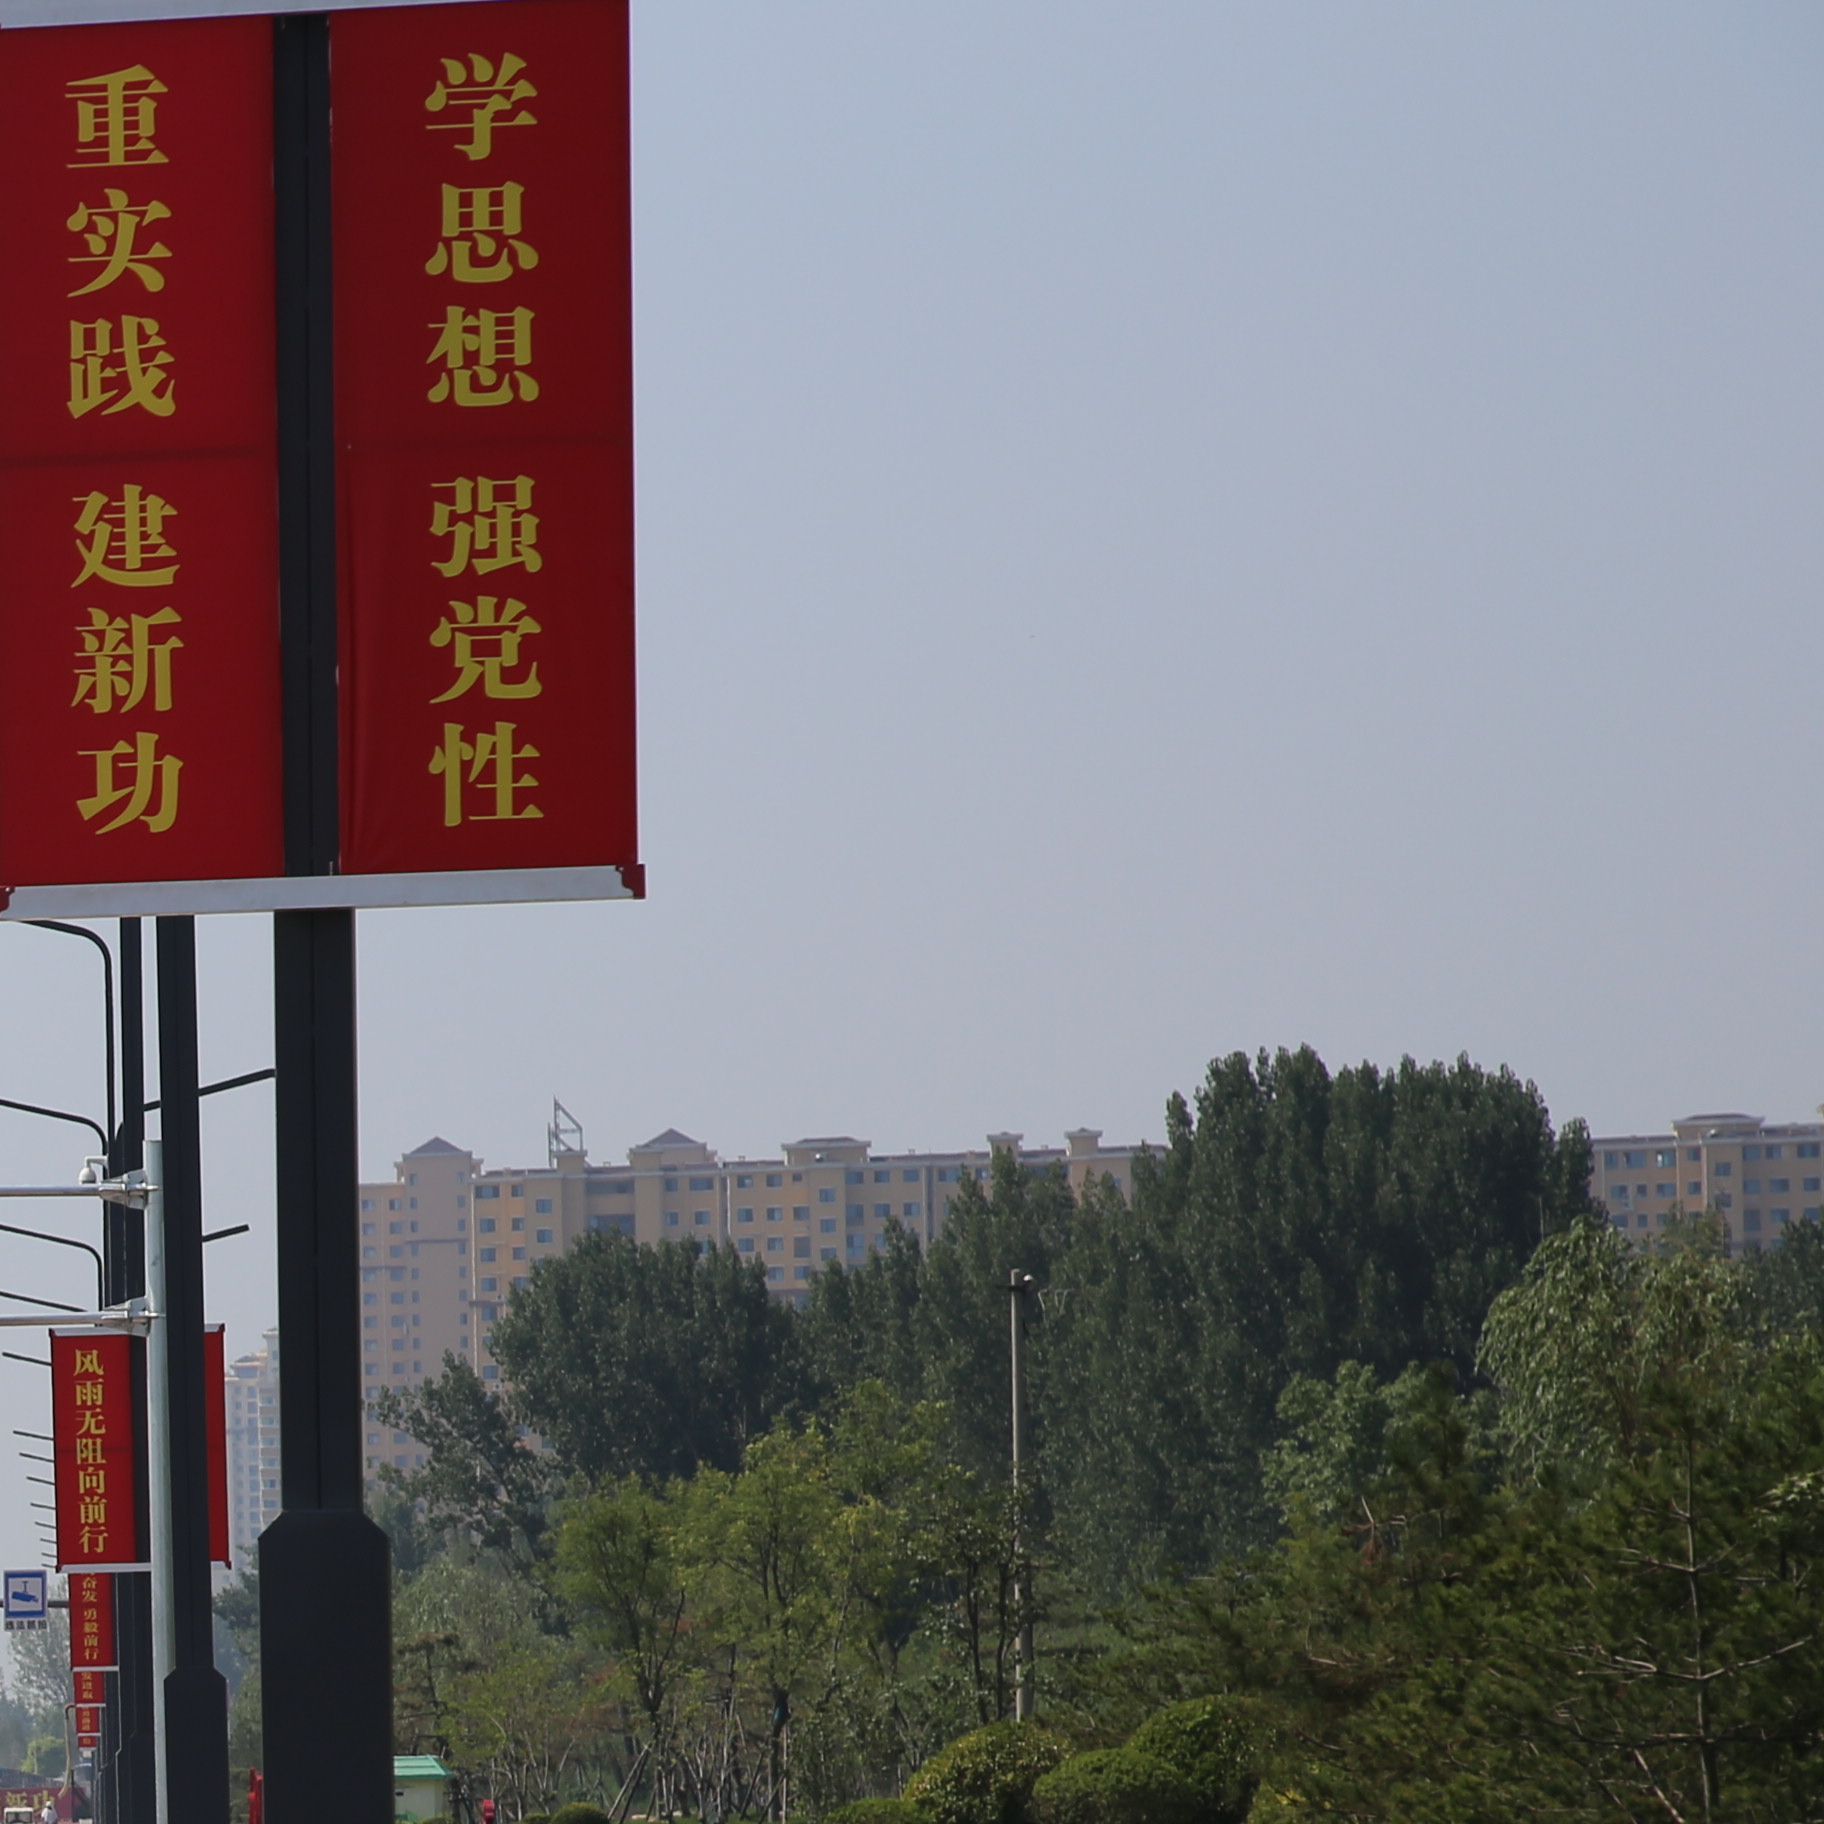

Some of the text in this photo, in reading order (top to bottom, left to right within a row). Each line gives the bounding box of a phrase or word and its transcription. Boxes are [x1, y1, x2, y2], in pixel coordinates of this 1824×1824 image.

[64, 63, 183, 834] 重实践 建新功
[424, 52, 544, 827] 学思想 强党性
[73, 1349, 109, 1554] 风雨无阻向前行
[5, 1620, 48, 1630] 违法抓拍
[81, 1573, 99, 1660] 奋发 勇毅前行
